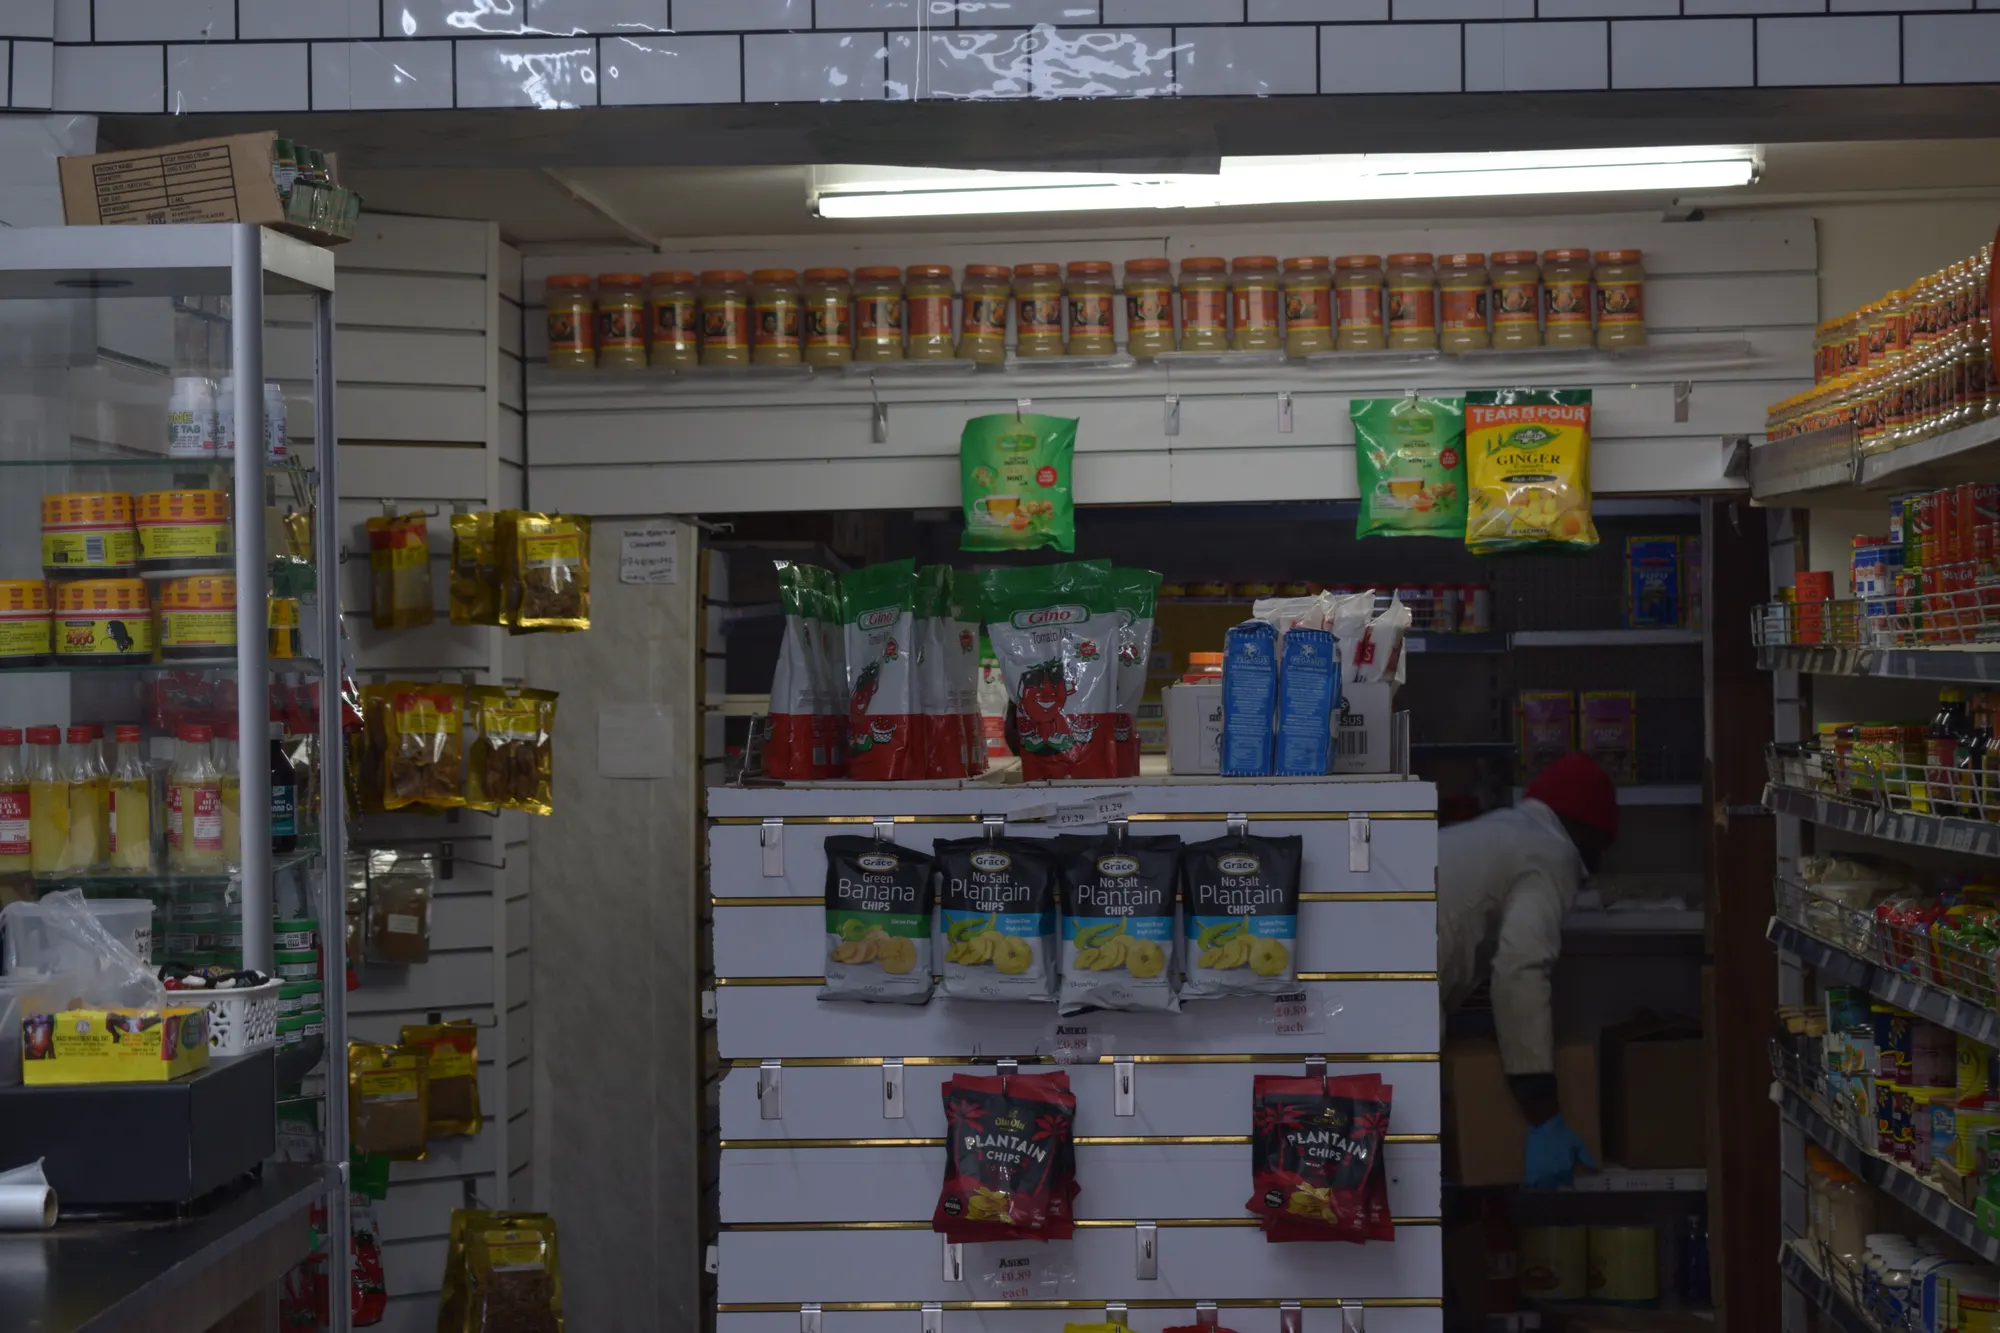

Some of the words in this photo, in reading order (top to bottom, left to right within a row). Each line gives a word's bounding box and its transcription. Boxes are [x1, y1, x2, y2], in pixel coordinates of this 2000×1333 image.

[1473, 407, 1519, 423] TEAR
[1537, 407, 1586, 422] POUR
[1496, 453, 1560, 466] GINGER
[869, 611, 893, 625] Gino
[1028, 610, 1071, 624] Gino
[1032, 629, 1058, 644] Tomato
[1235, 656, 1269, 665] PEGASUS
[1292, 656, 1325, 666] PEGASUS
[1099, 803, 1123, 813] £1.29
[1061, 814, 1084, 823] £1.29
[863, 858, 893, 867] Grace
[976, 857, 1006, 866] Grace
[1103, 861, 1133, 871] Grace
[1223, 860, 1254, 870] Grace
[862, 872, 894, 884] Green
[972, 872, 987, 882] No
[989, 873, 1010, 884] Salt
[1100, 877, 1114, 887] No
[1117, 877, 1138, 887] Salt
[1221, 876, 1236, 886] No
[1238, 876, 1259, 887] Salt
[838, 878, 915, 902] Banana
[950, 878, 1031, 901] Plantain
[1078, 884, 1162, 906] Plantain
[1200, 884, 1283, 905] Plantain
[862, 901, 891, 911] CHIPS
[975, 900, 1005, 912] CHIPS
[1105, 905, 1134, 916] CHIPS
[1227, 904, 1256, 915] CHIPS
[1277, 1022, 1303, 1032] each
[964, 1134, 1046, 1163] PLANTAIN
[1286, 1131, 1368, 1160] PLANTAIN
[986, 1150, 1021, 1164] CHIPS
[1308, 1147, 1342, 1161] CHIPS
[1002, 1287, 1028, 1298] each
